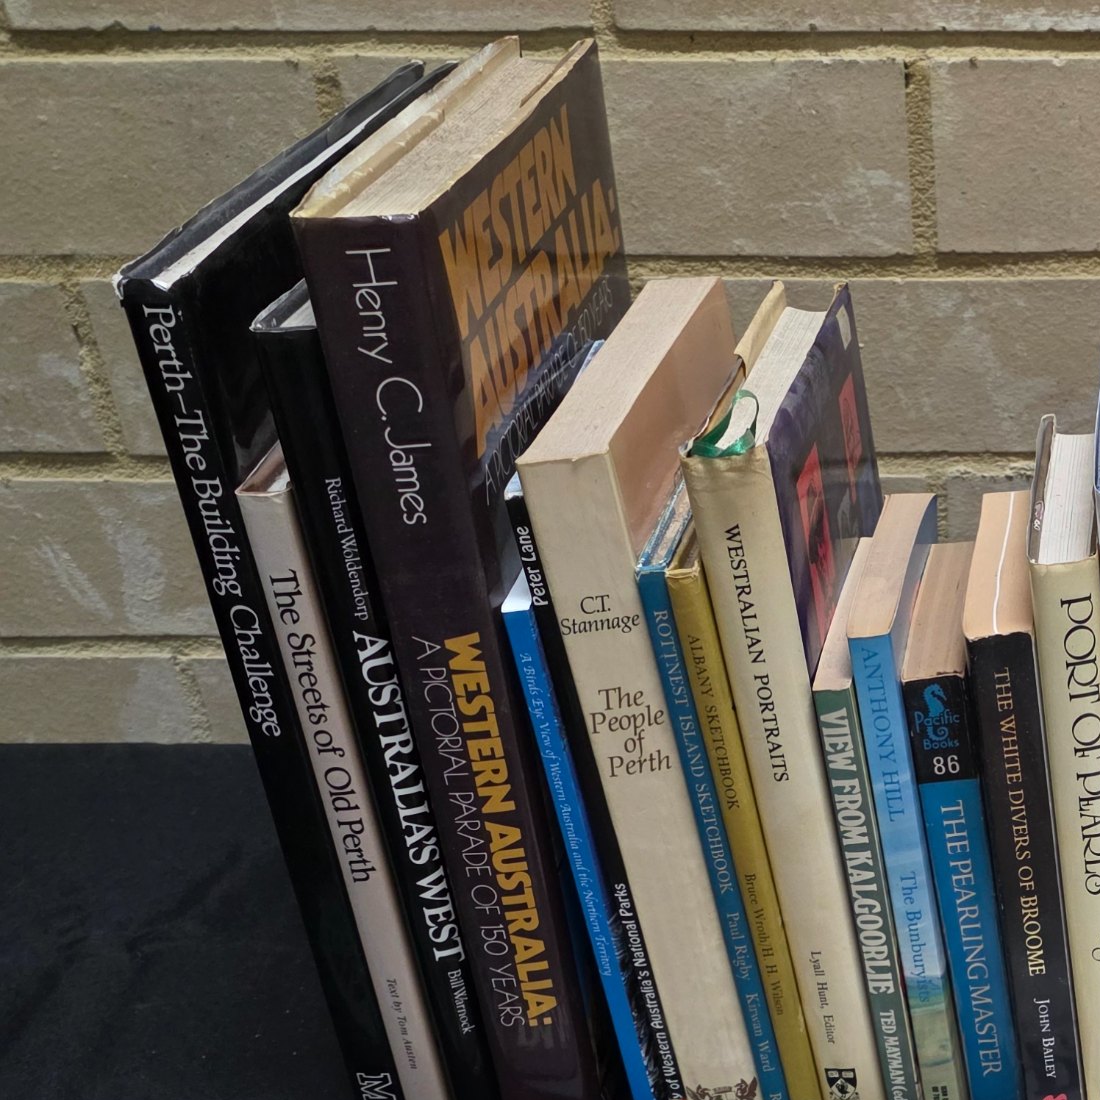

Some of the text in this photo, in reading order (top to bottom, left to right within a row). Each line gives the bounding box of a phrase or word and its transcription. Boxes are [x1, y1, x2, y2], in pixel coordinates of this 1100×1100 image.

[439, 103, 577, 340] WESTERN
[345, 247, 433, 525] Henry C. James
[191, 476, 242, 597] Building
[229, 603, 281, 739] Challenge
[325, 477, 369, 621] Richard Woldendorp
[517, 525, 549, 606] Peter Lane
[580, 595, 611, 615] C.T.
[560, 613, 640, 636] Stannage
[724, 523, 790, 783] WESTRALIAN PORTRAITS
[269, 568, 377, 883] The Streets of Old Perth
[589, 705, 665, 735] People
[598, 687, 645, 712] The
[608, 749, 672, 778] Perth
[624, 728, 646, 757] of
[653, 610, 734, 895] ROTTNEST ISLAND SKETCHBOOK
[688, 634, 740, 810] ALBANY SKETCHBOOK
[862, 648, 905, 822] ANTHONY HILL
[915, 709, 961, 733] Pacific
[923, 739, 960, 750] Books
[933, 755, 960, 775] 86
[353, 631, 465, 962] AUSTRALIA'S WEST
[411, 636, 525, 1027] A PICTORIAL PARADE OF 150 YEARS
[444, 632, 558, 1028] WESTERN AUSTRALIA:
[820, 707, 895, 995] VIEW FROM KALGOORLIE
[993, 667, 1046, 976] THE WHITE DIVERS OF BROOME
[448, 968, 476, 1035] Bill Warnock
[900, 871, 929, 1003] The Bunburyists
[940, 800, 1002, 1077] THE PEARLING MASTER
[880, 1009, 897, 1034] TED
[1034, 998, 1057, 1079] JOHN BAILEY
